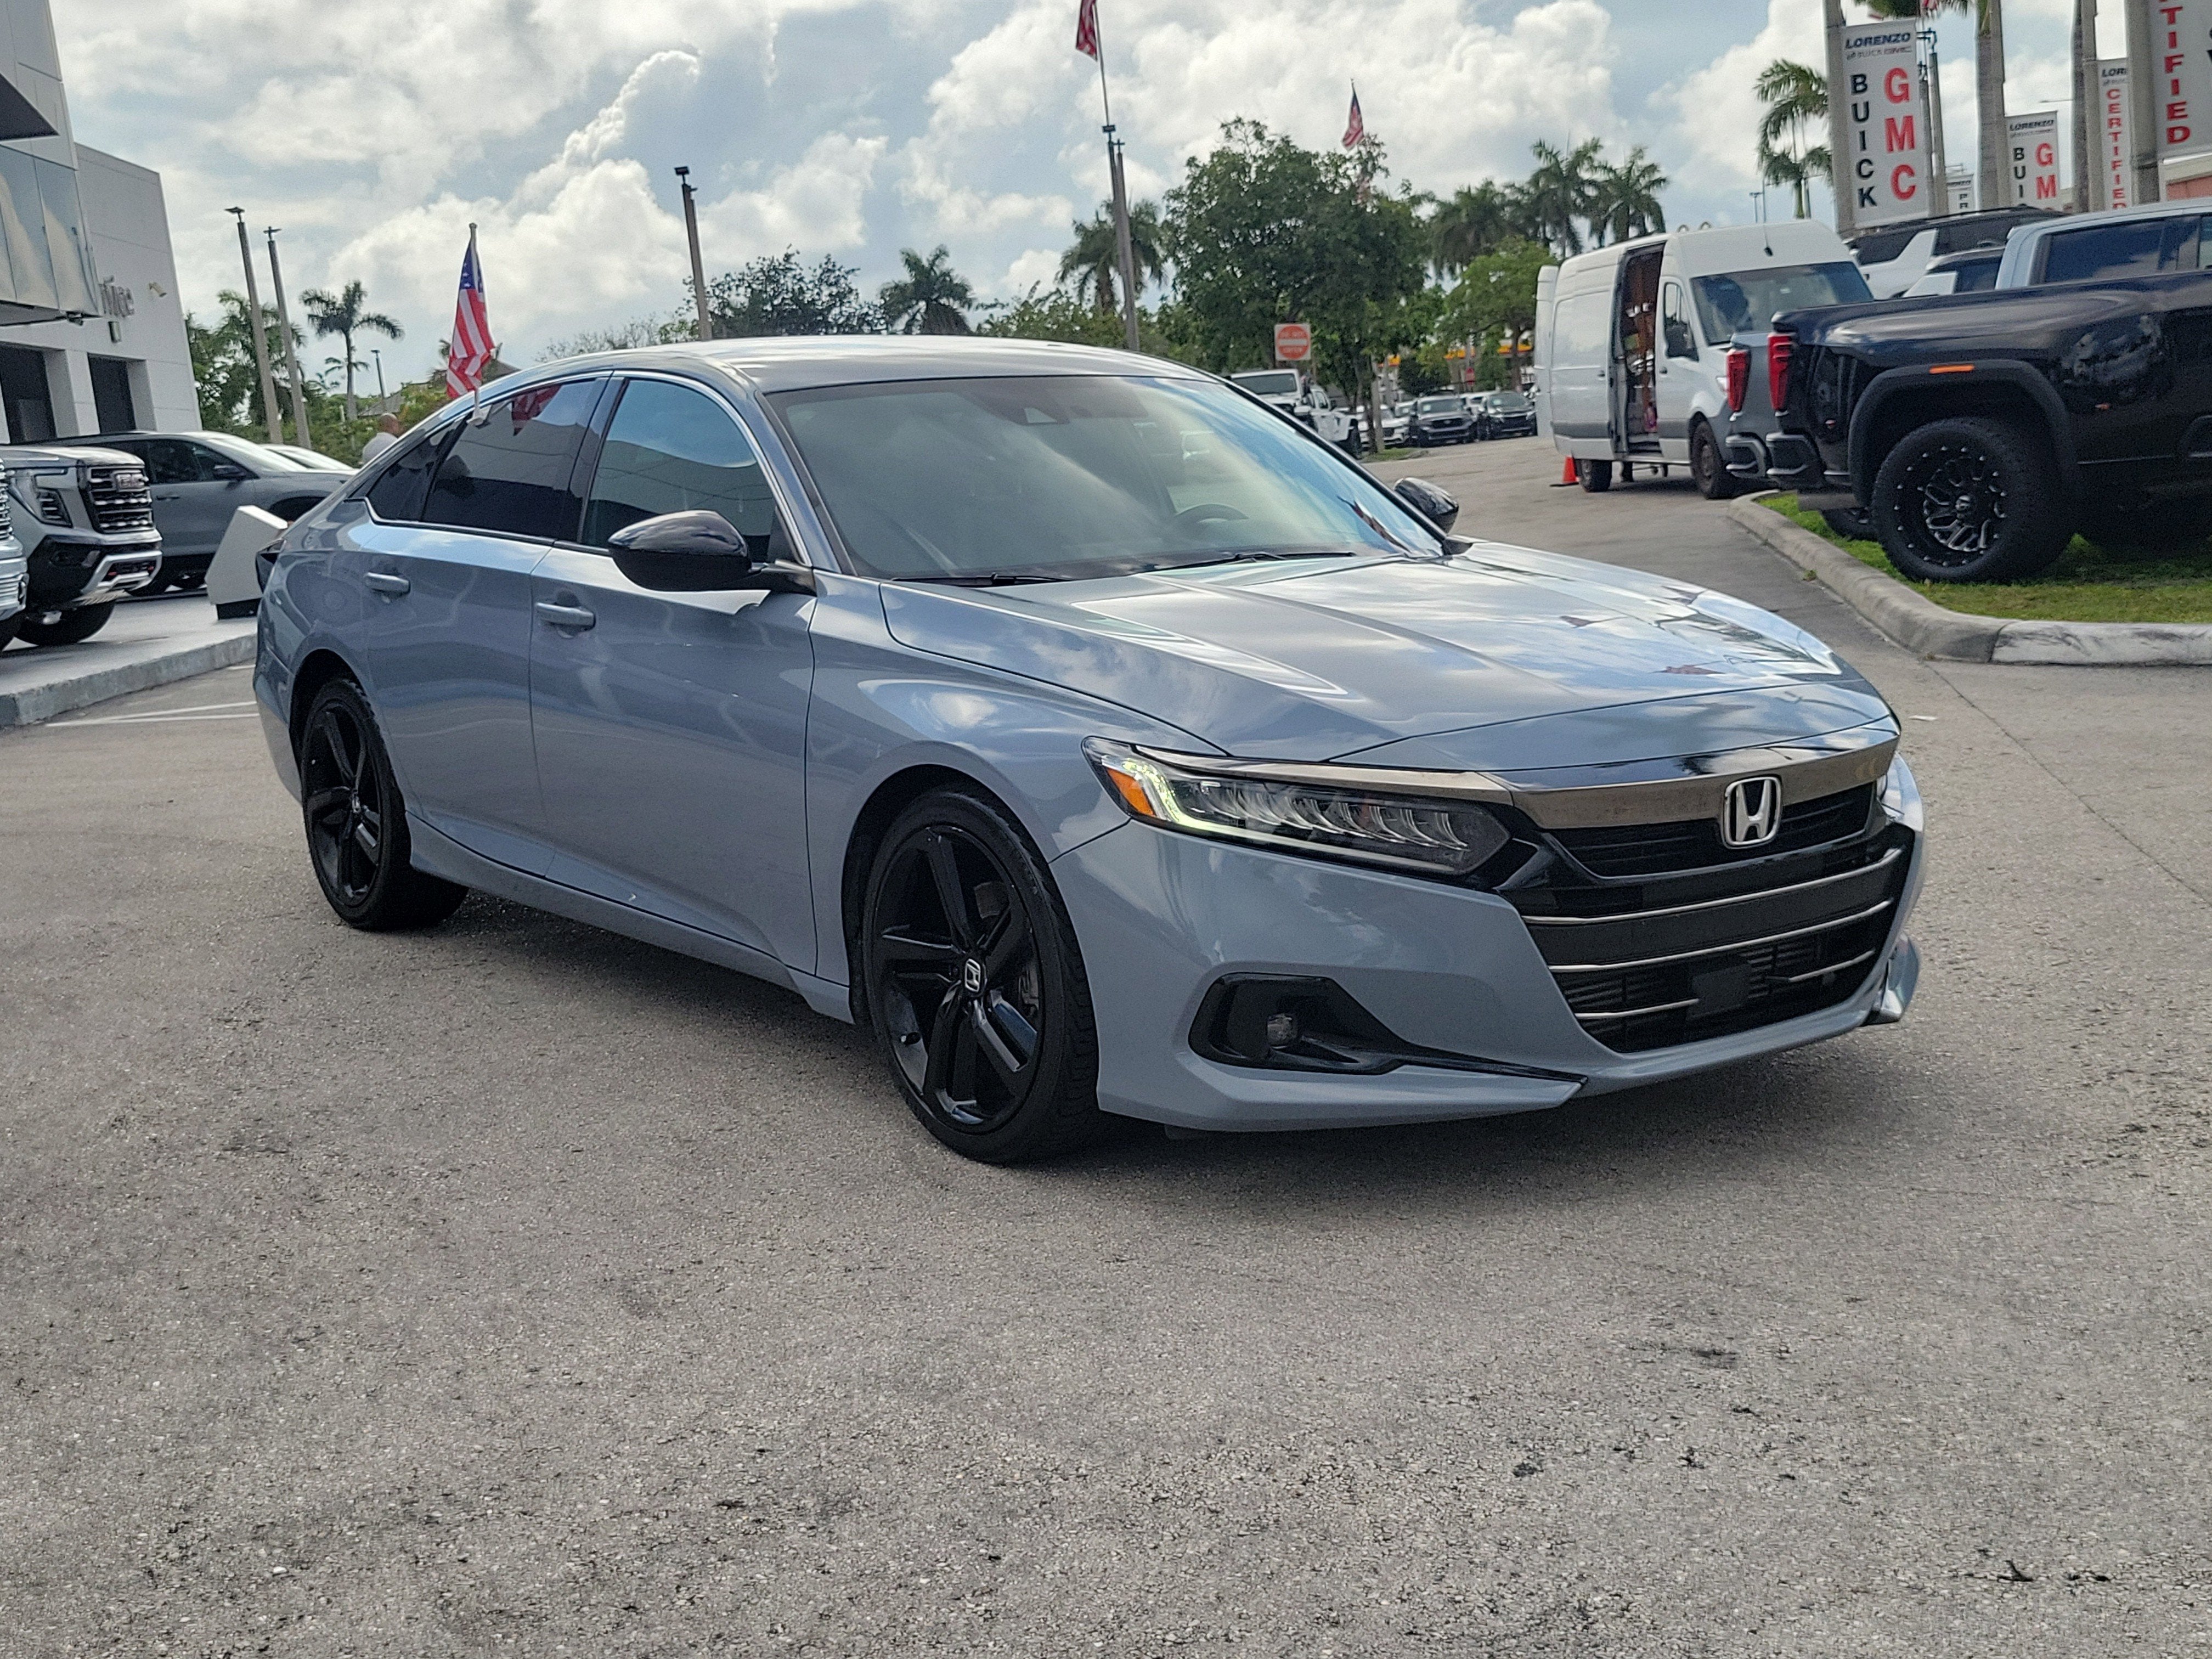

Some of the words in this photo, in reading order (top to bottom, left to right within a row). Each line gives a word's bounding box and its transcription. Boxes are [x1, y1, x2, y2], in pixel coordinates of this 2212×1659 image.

[1845, 33, 1911, 49] LORENZO
[2102, 67, 2127, 77] LOR
[2159, 0, 2191, 145] TIFIED
[1850, 73, 1878, 209] BUICK
[1884, 67, 1916, 201] GMC
[2013, 147, 2027, 206] BUI
[2035, 143, 2056, 211] GM
